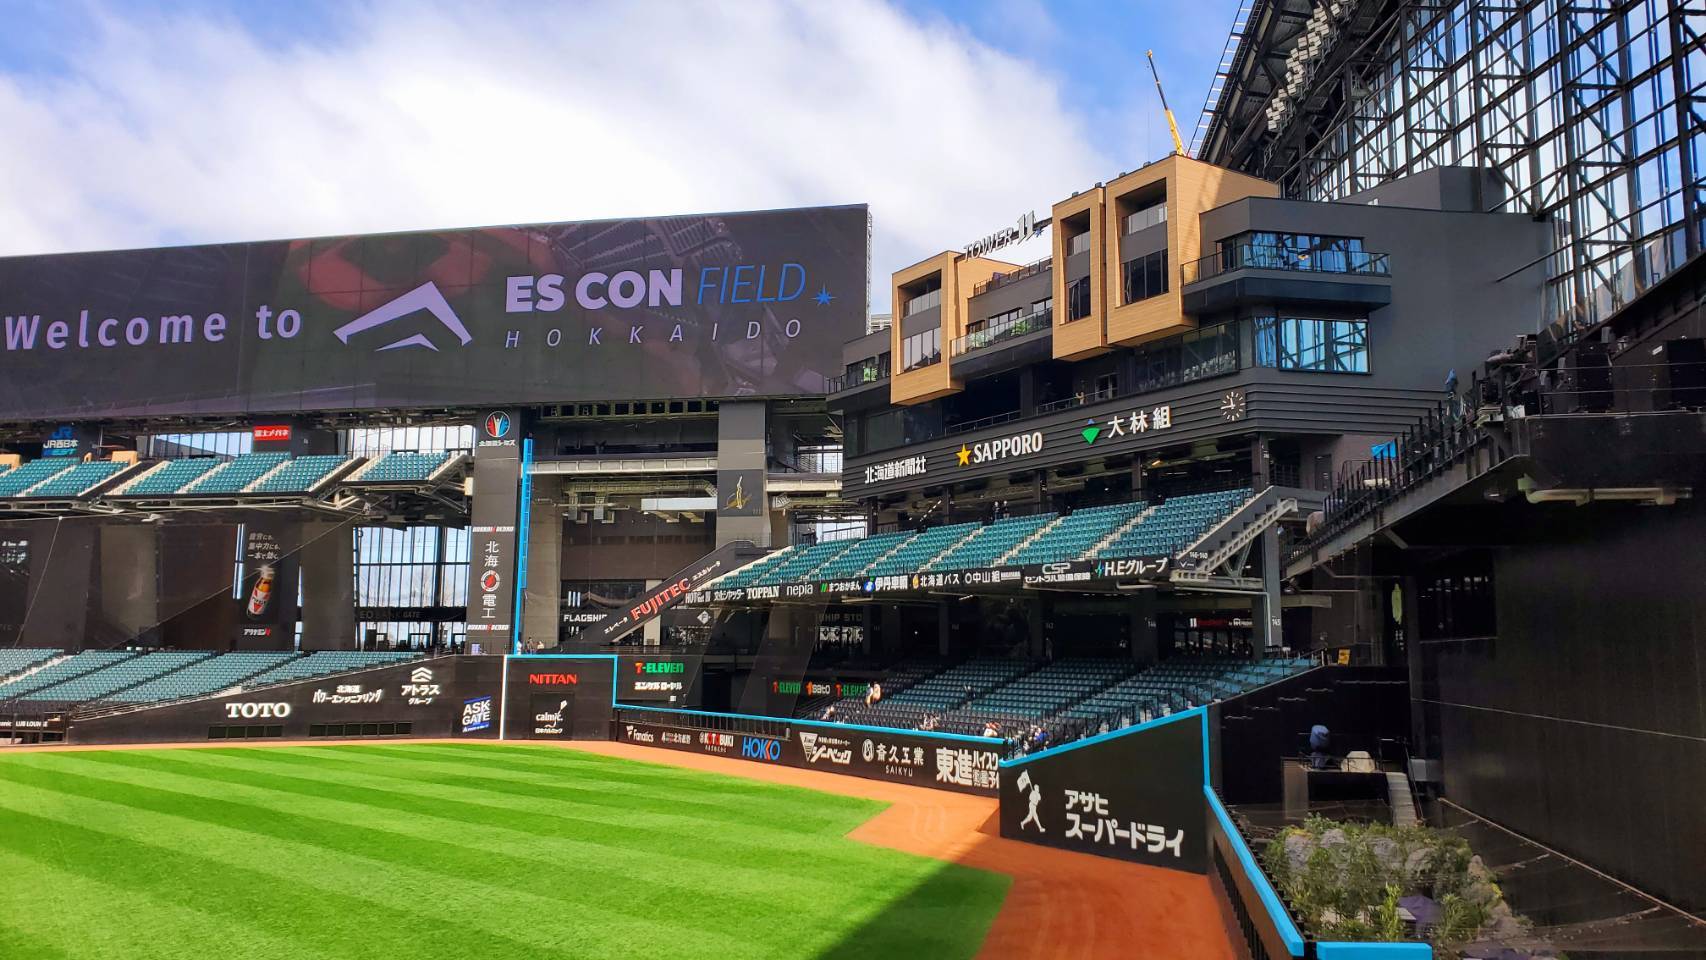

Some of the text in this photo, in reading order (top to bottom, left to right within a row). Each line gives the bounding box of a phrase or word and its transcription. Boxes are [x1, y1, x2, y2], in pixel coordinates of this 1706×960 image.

[963, 210, 1036, 262] TOWER 11
[505, 263, 806, 312] ES CON FIELD
[5, 305, 300, 350] Welcome to
[505, 319, 801, 349] HOKKAIDO
[1107, 406, 1172, 439] 大林組
[43, 439, 78, 449] JR西日本
[973, 431, 1043, 463] SAPPORO
[865, 456, 927, 485] 北海道新聞社
[1041, 562, 1071, 575] CSP
[1105, 557, 1168, 577] H.Eグループ
[920, 573, 960, 587] 北海道バス
[972, 570, 1000, 583] 中山組
[746, 585, 780, 599] TOPPAN
[786, 582, 814, 598] nepia
[630, 577, 691, 621] FUJITEC
[529, 673, 577, 685] NITTAN
[401, 684, 441, 697] アトラス
[225, 702, 291, 718] TOTO
[463, 700, 491, 716] ASK
[462, 711, 491, 726] GATE
[704, 731, 734, 747] KOTOBUKI
[885, 765, 913, 778] SAIKYU
[935, 746, 972, 787] 東進
[1064, 789, 1109, 816] アサヒ
[1064, 812, 1185, 857] スーパードライ
